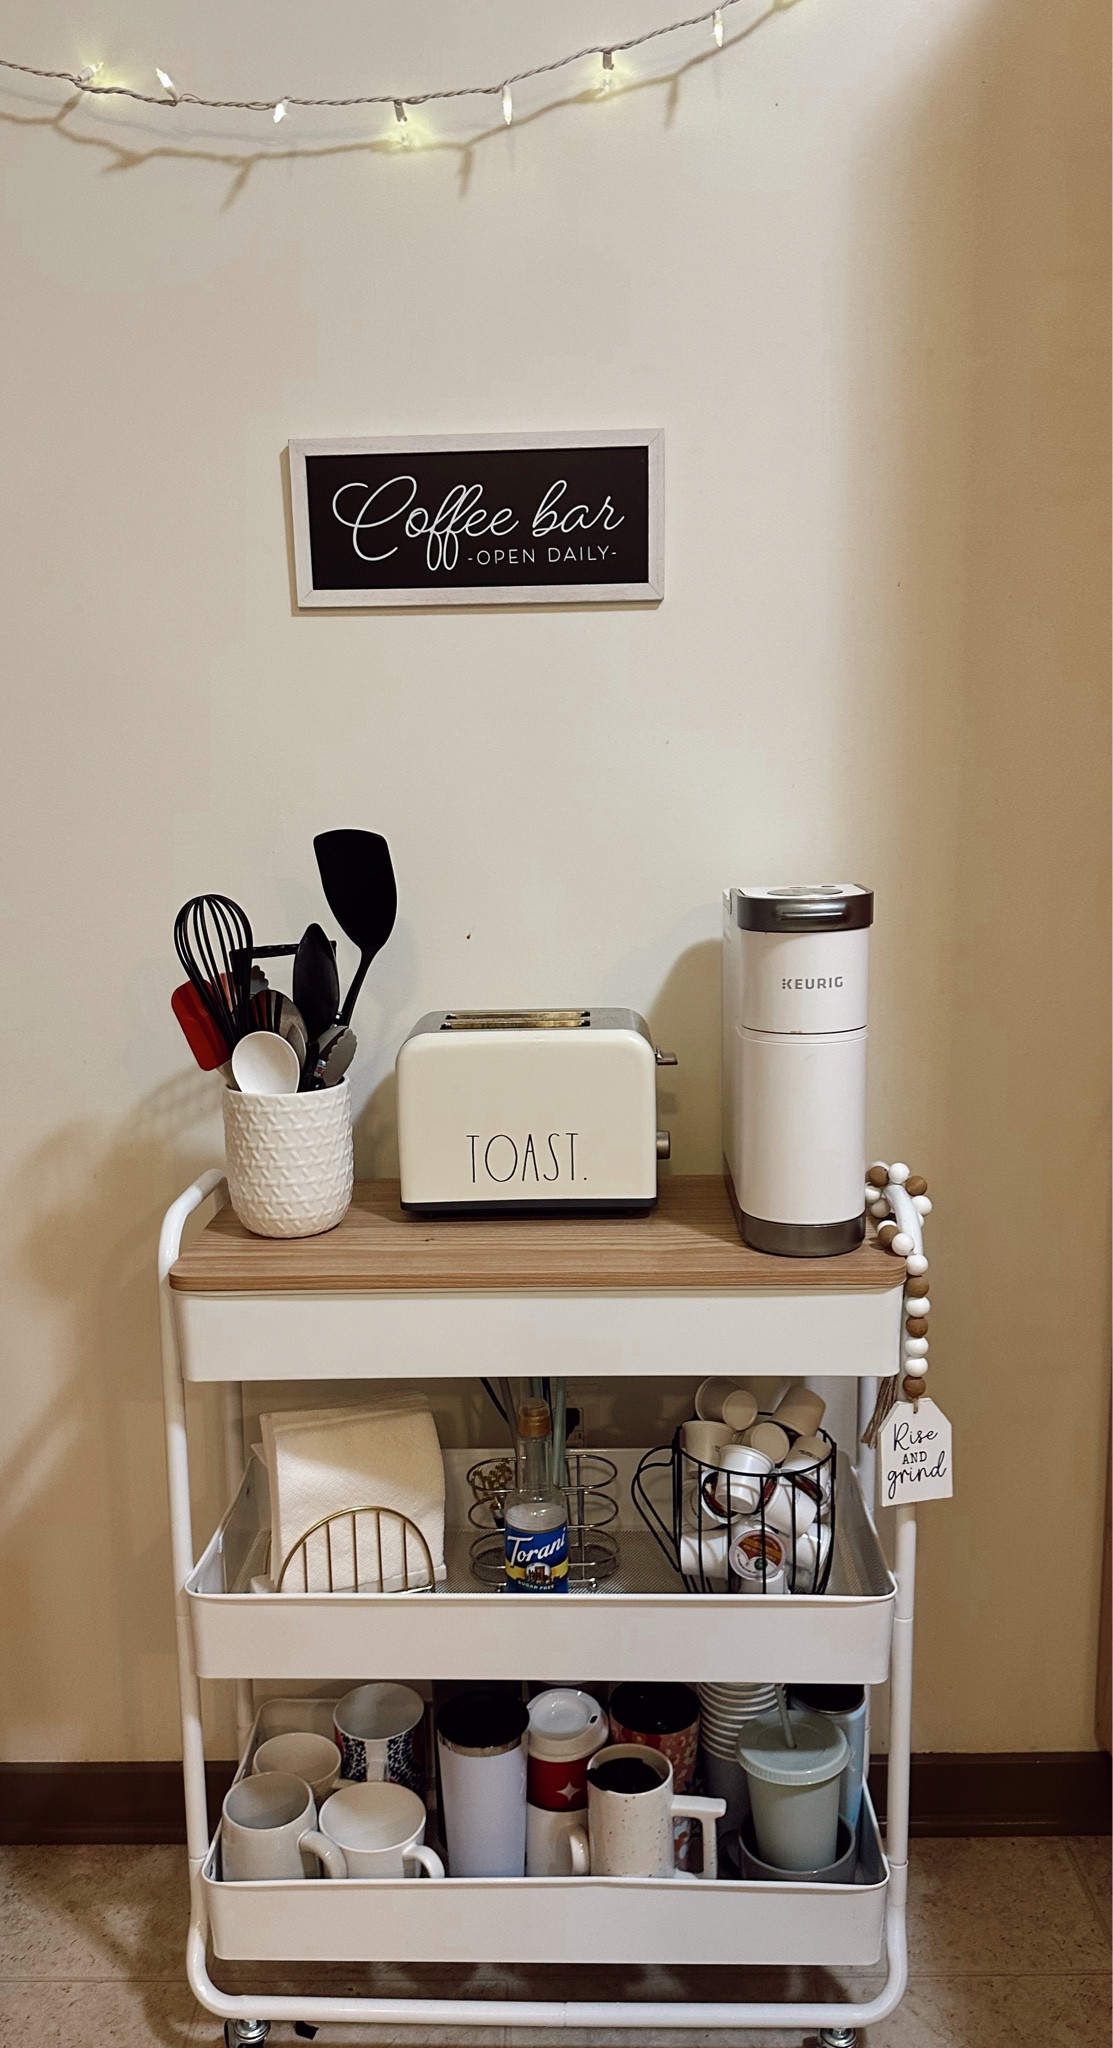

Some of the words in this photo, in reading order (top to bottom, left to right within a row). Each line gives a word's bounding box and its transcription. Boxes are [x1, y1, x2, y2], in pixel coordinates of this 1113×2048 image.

[332, 475, 519, 571] Coffee
[532, 480, 625, 538] bar
[781, 976, 844, 990] KEURIG
[466, 1132, 588, 1183] TOAST.
[893, 1422, 939, 1451] Rise
[887, 1450, 947, 1500] grind
[902, 1451, 928, 1465] AND
[507, 1526, 566, 1566] Torani
